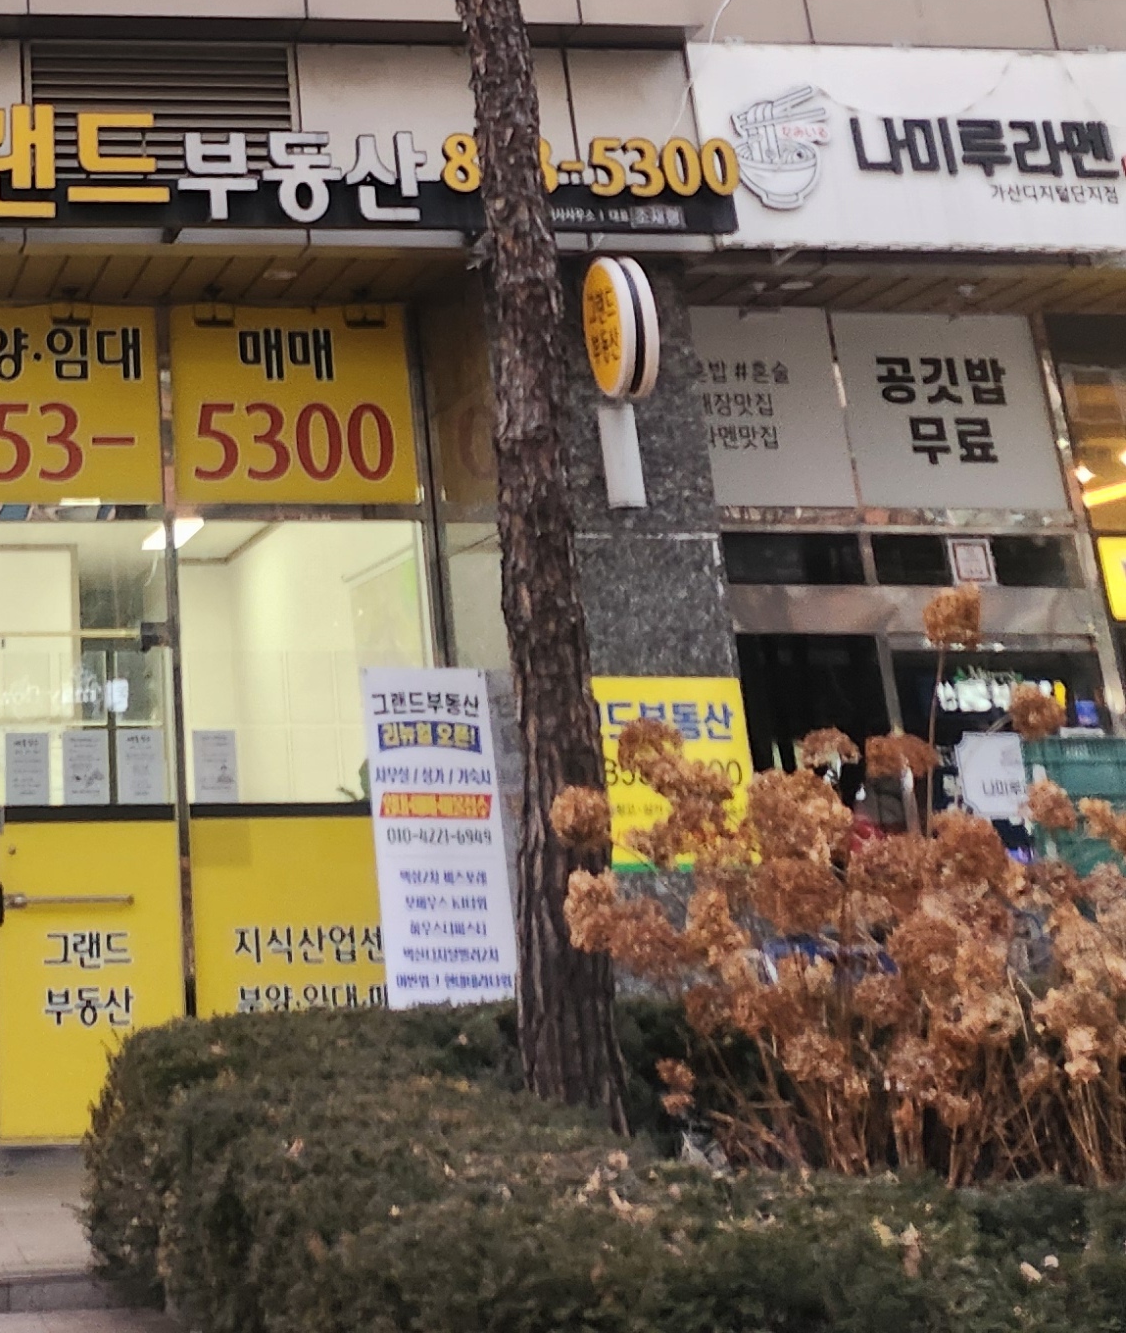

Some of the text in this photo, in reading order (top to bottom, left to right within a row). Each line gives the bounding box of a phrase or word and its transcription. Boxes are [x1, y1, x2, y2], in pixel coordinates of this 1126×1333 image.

[441, 133, 740, 197] 83-5300
[849, 116, 1120, 179] 나미루라멘
[991, 183, 1120, 205] 가산디지털단지점
[238, 328, 334, 381] 매매
[875, 356, 1008, 407] 공깃밥
[194, 402, 395, 482] 5300
[909, 416, 999, 466] 무료
[372, 691, 480, 717] 그랜드부동산
[382, 721, 432, 746] 리뉴얼
[44, 931, 132, 969] 그랜드
[44, 986, 134, 1026] 부동산
